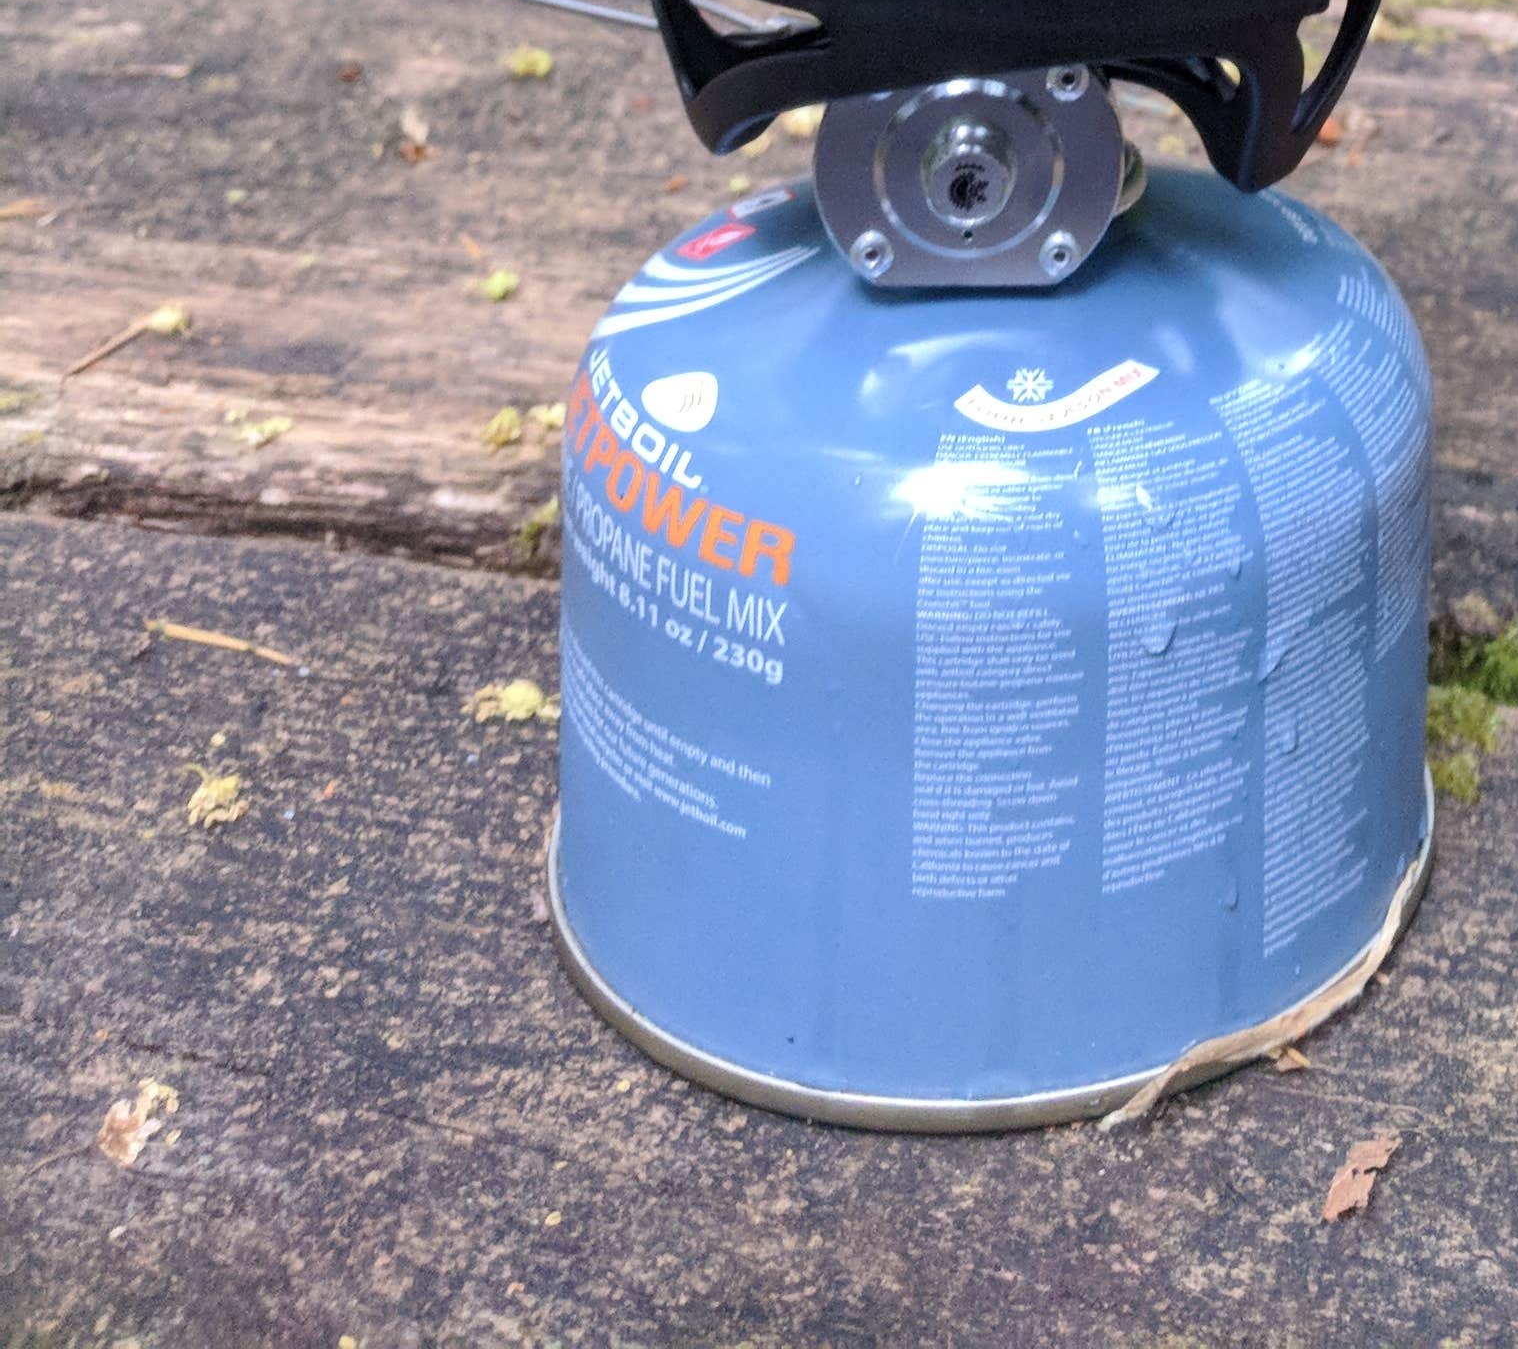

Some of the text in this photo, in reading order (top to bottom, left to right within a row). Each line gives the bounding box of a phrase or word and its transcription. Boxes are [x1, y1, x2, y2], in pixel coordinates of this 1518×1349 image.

[589, 348, 703, 490] JETBOIL
[576, 481, 788, 647] PROPANE FUEL MIX
[664, 618, 694, 648] oz
[712, 635, 784, 686] 230g
[669, 734, 708, 766] empty
[709, 755, 736, 776] and
[737, 764, 772, 788] then
[653, 785, 748, 839] www.jetboil.com
